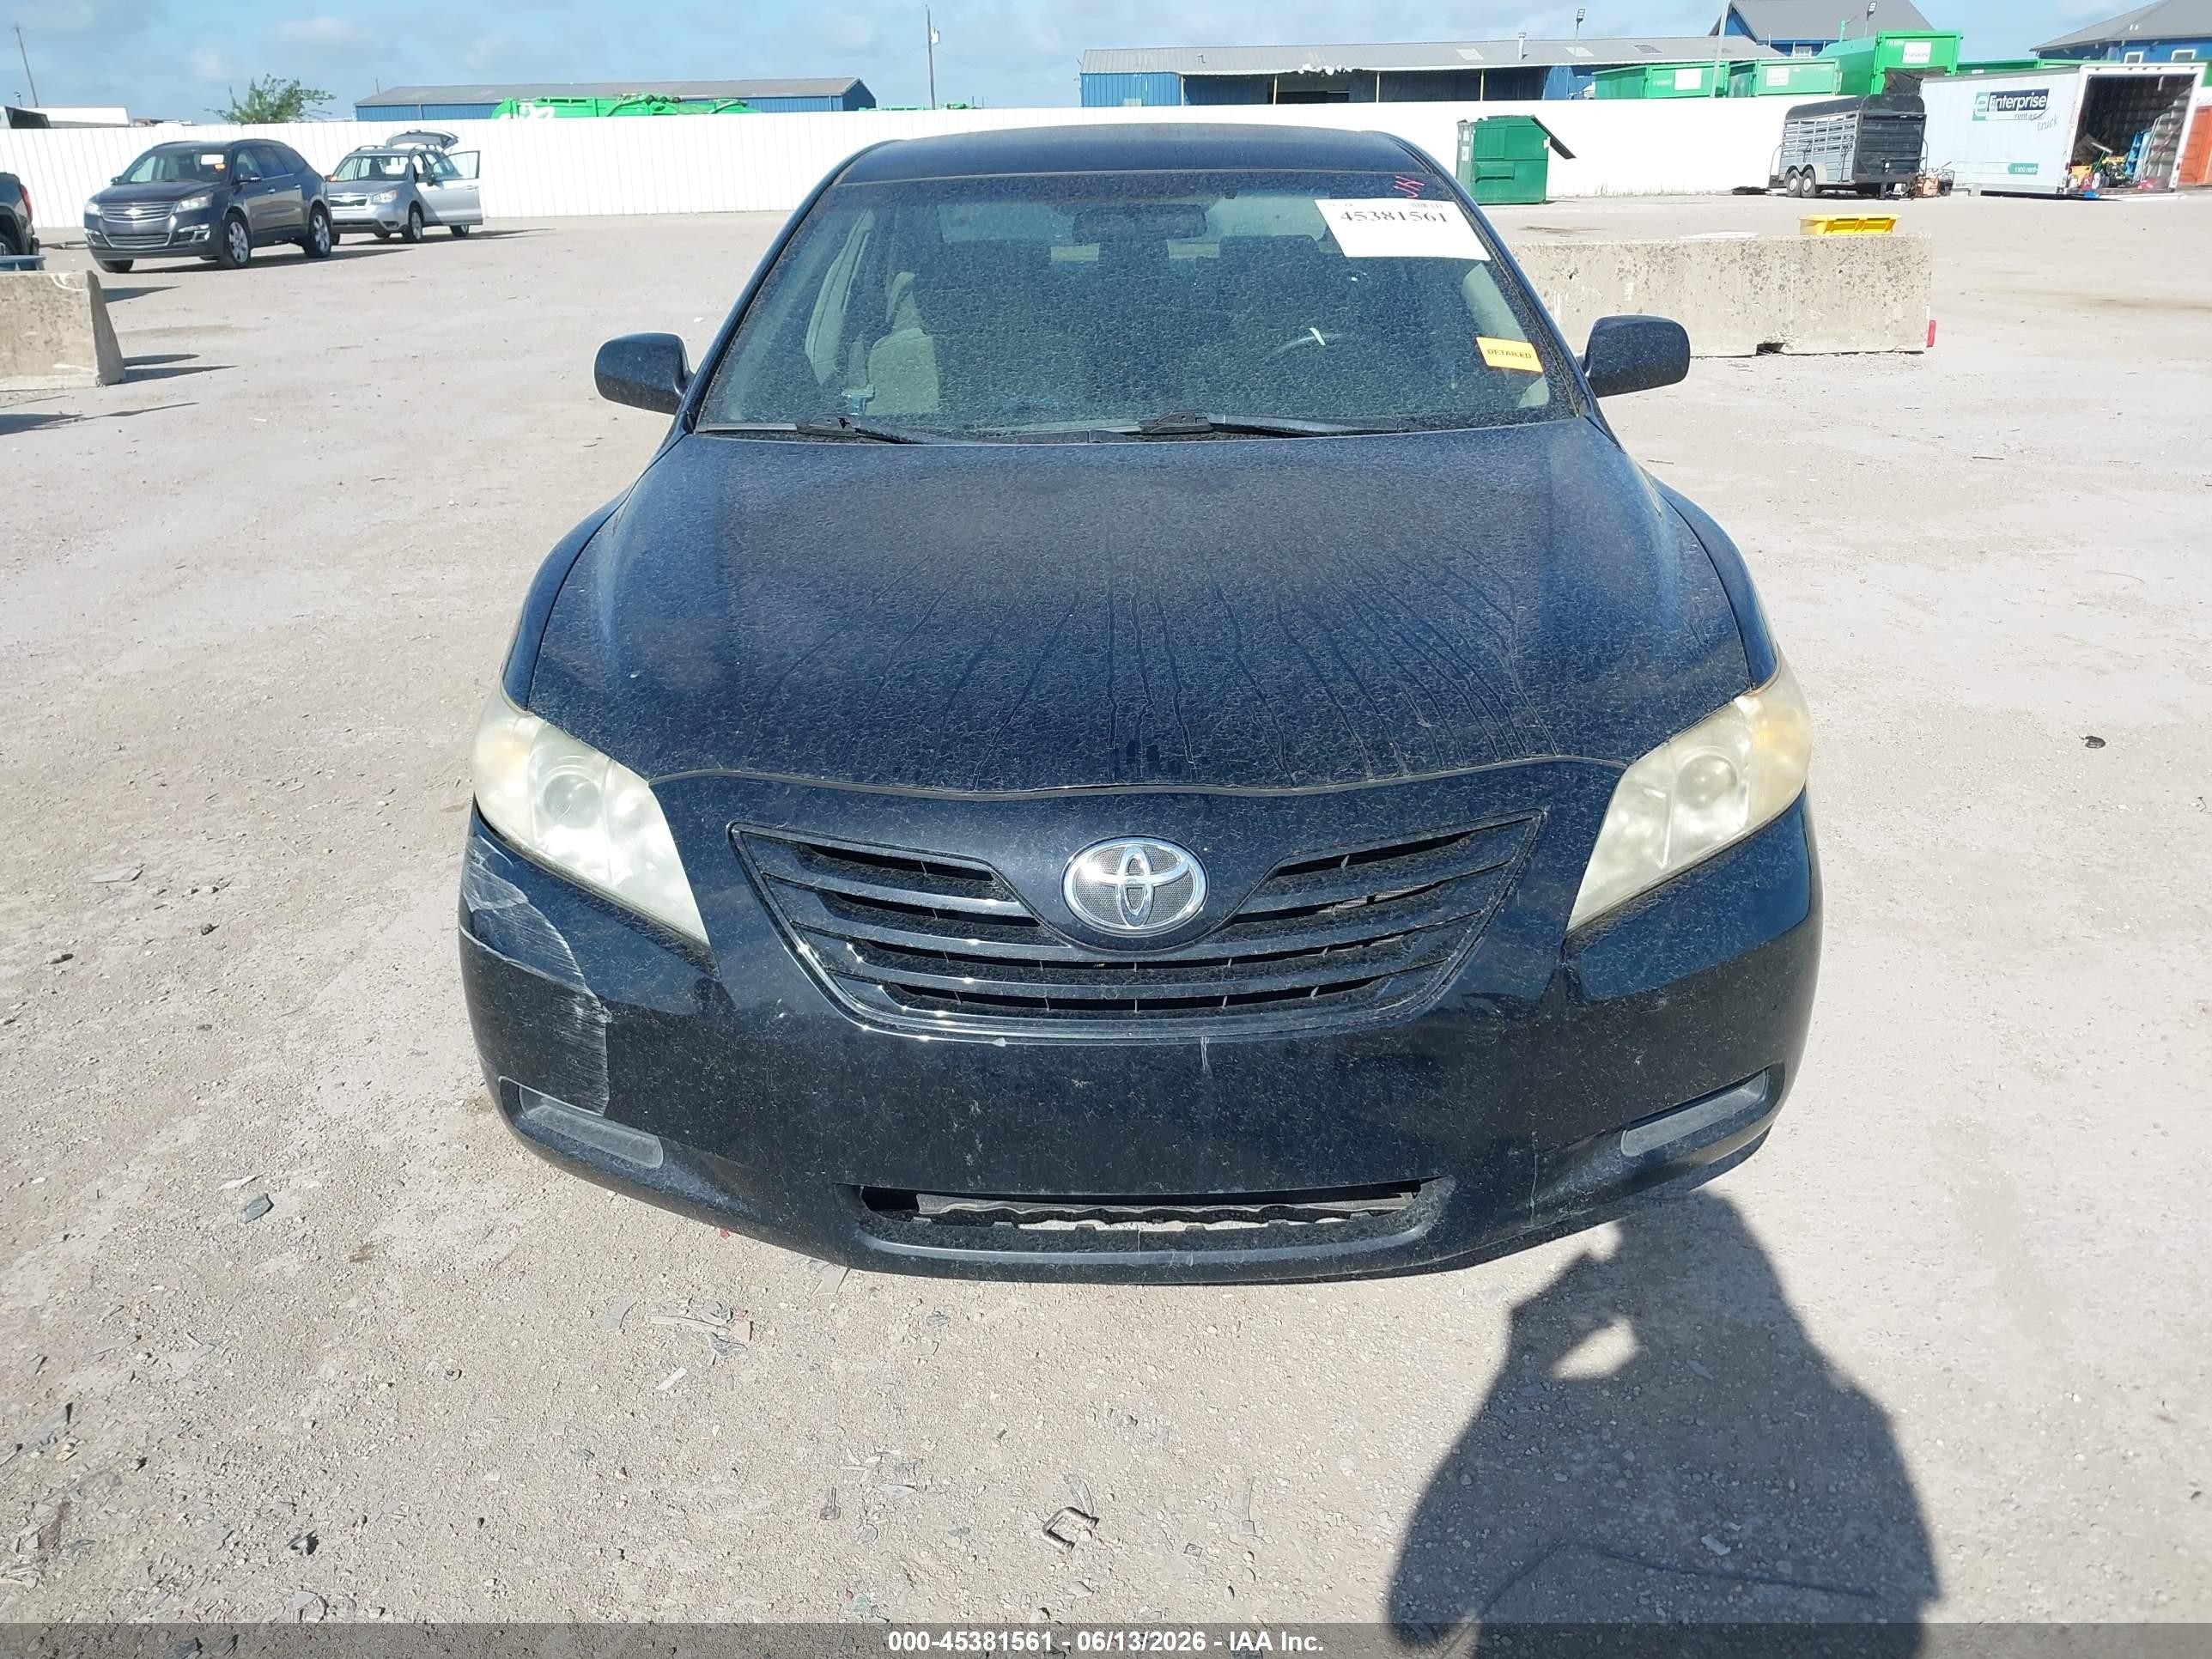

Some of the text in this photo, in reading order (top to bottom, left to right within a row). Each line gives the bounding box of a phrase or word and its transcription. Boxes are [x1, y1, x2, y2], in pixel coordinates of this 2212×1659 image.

[1989, 92, 2047, 111] Enterprise
[2037, 113, 2058, 131] truck
[1340, 211, 1449, 223] 45381561
[1486, 349, 1532, 359] DETAILED
